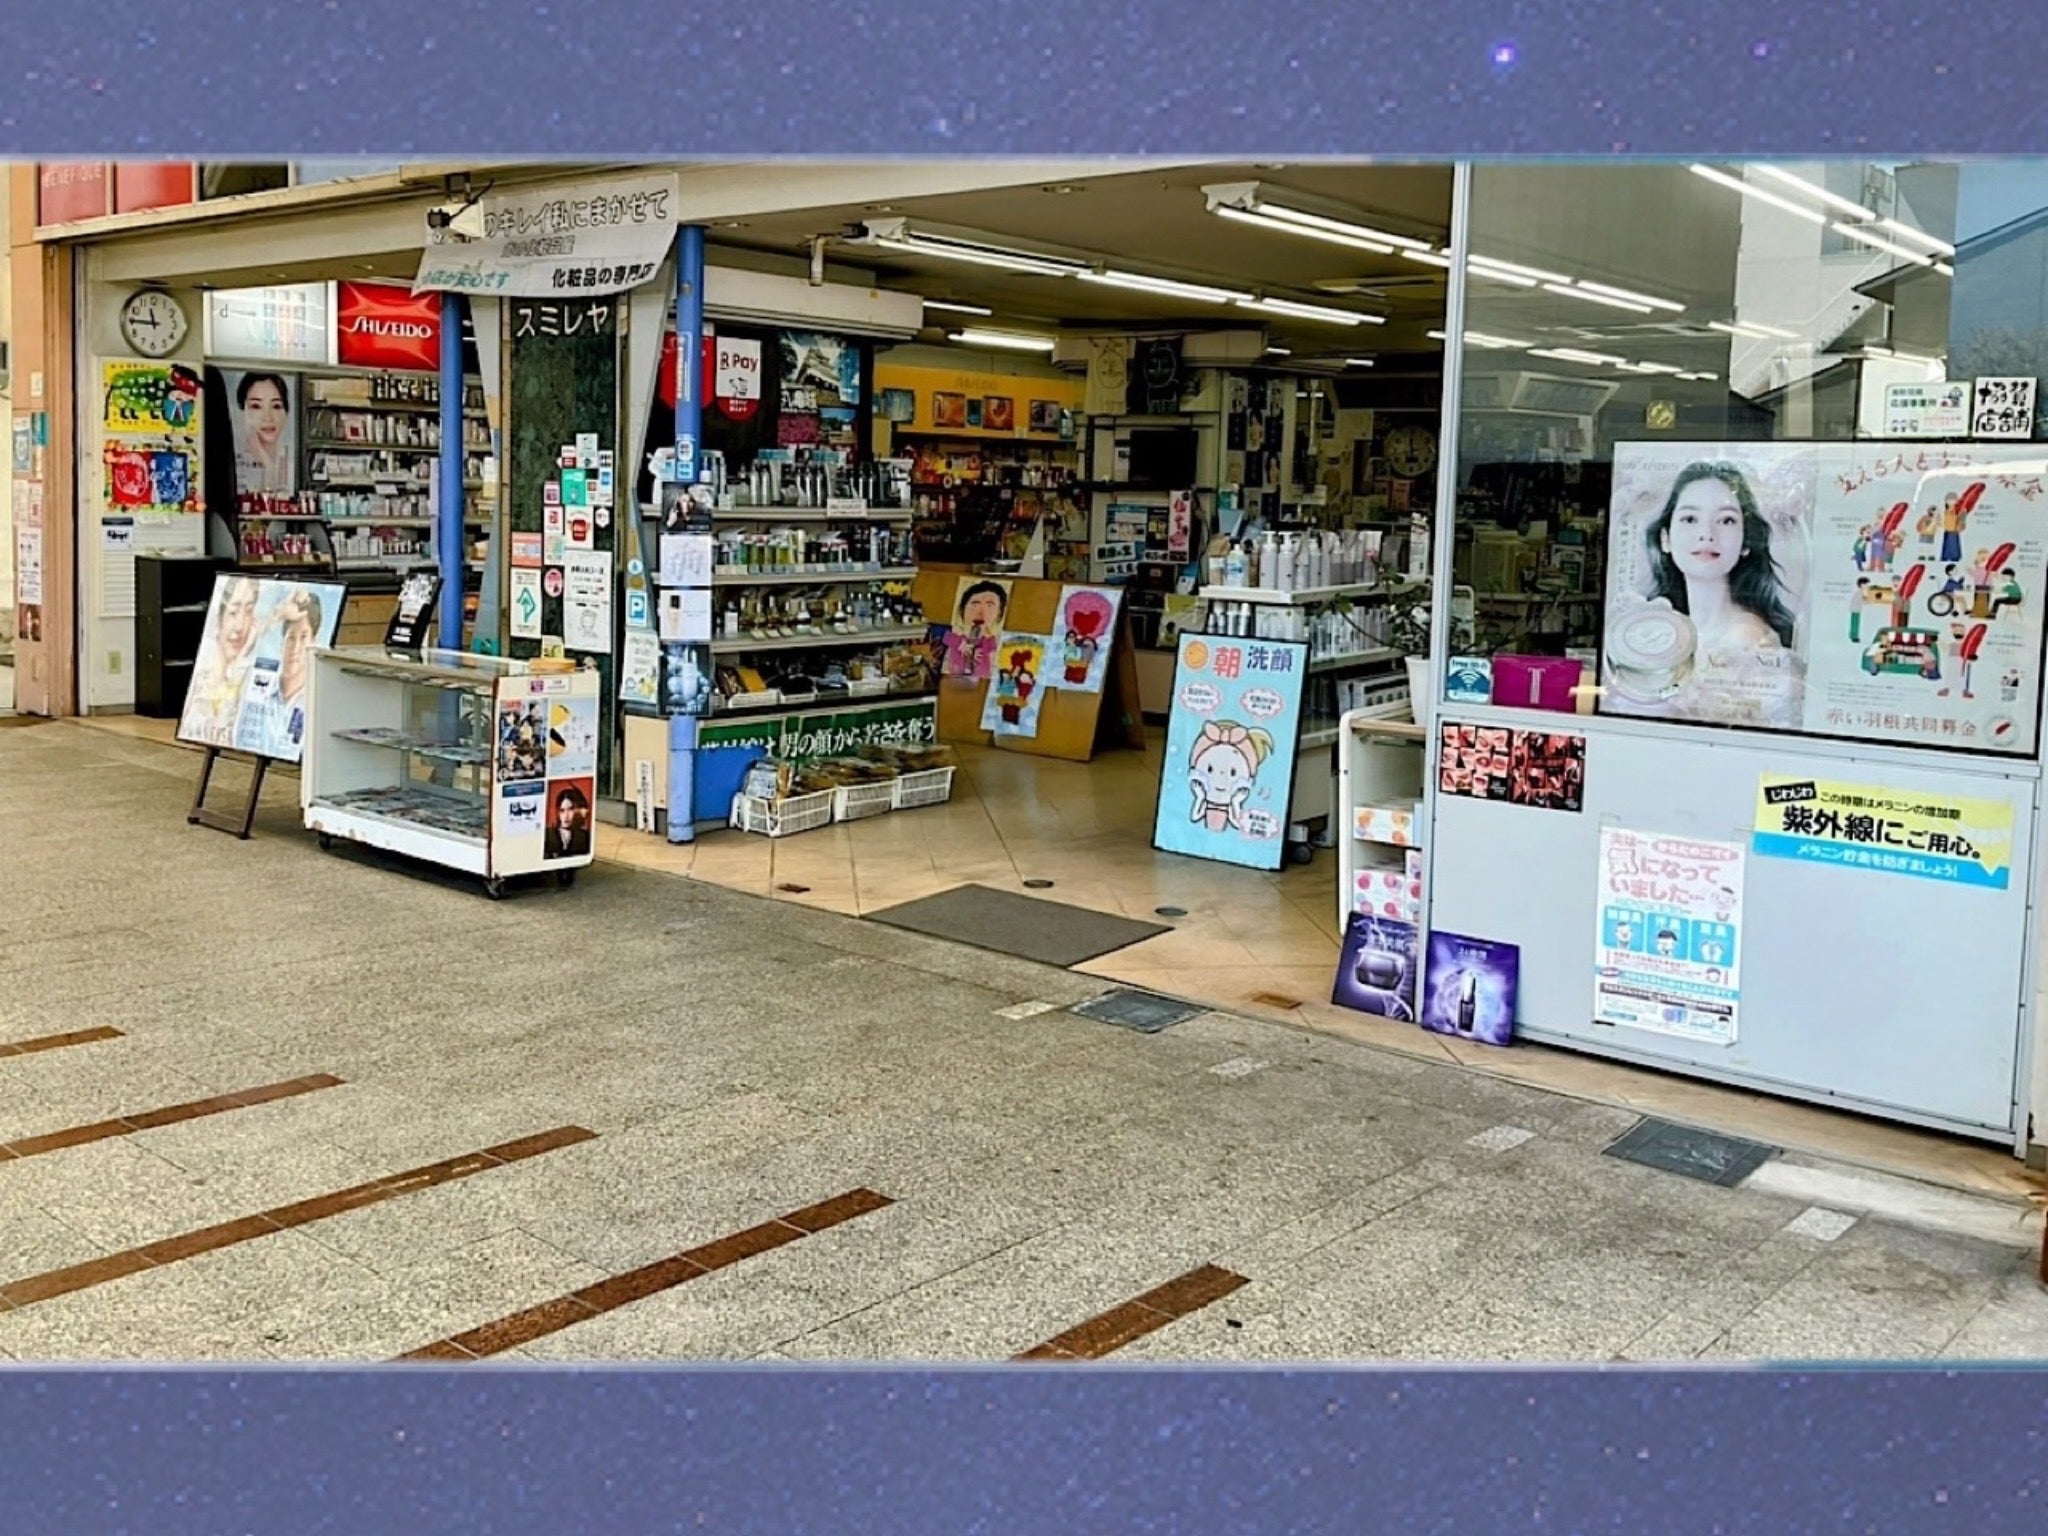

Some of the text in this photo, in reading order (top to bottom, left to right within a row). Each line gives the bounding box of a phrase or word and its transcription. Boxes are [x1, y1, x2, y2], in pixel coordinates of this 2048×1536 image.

[432, 189, 669, 245] のキレイ私にまかせて
[350, 315, 432, 338] SHISEIDO
[516, 300, 609, 337] スミレヤ
[733, 352, 759, 372] Pay
[1825, 707, 1978, 738] 赤い羽根共同募金
[1770, 784, 1814, 800] じわじわ
[1782, 804, 1981, 860] 紫外線にご用心。
